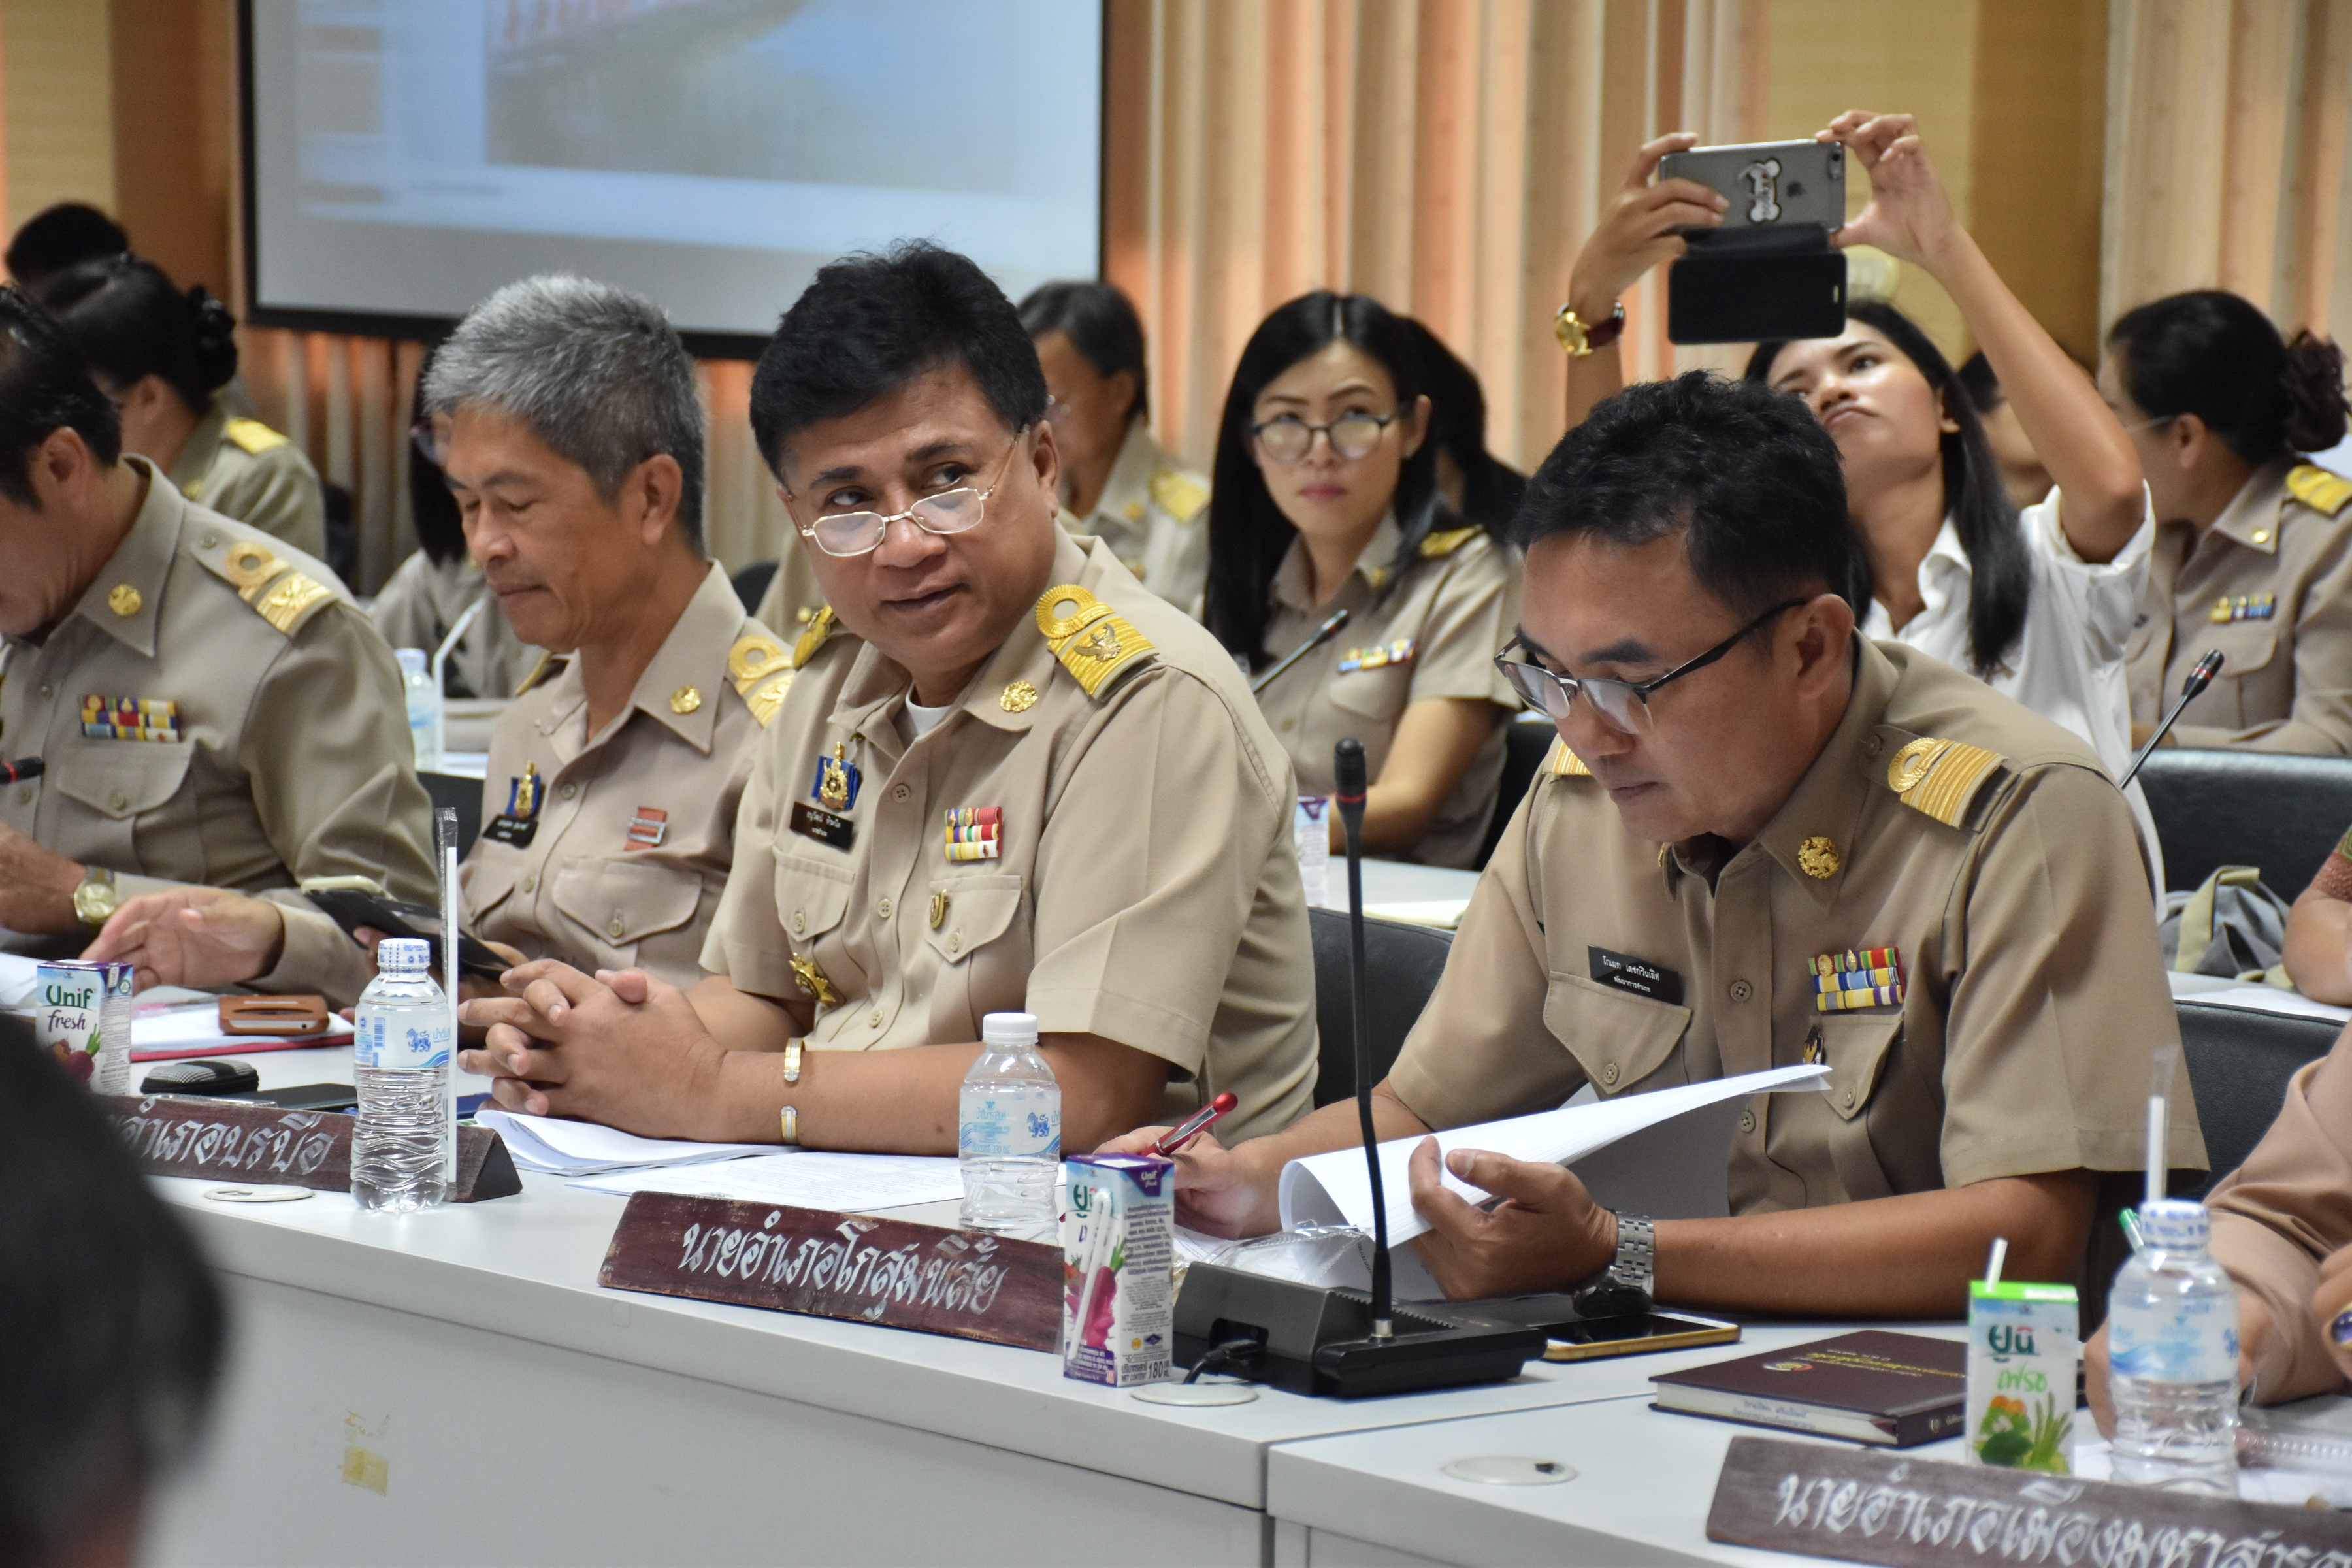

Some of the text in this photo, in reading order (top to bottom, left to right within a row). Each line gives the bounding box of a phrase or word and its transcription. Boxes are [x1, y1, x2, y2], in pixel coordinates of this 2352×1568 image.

[46, 985, 93, 1009] Unif
[48, 1009, 86, 1033] fresh
[108, 1095, 338, 1175] อำเภอบรบือ
[678, 1209, 1010, 1321] นายอำเภอโกสุมพิสัย
[1149, 1361, 1164, 1379] 180
